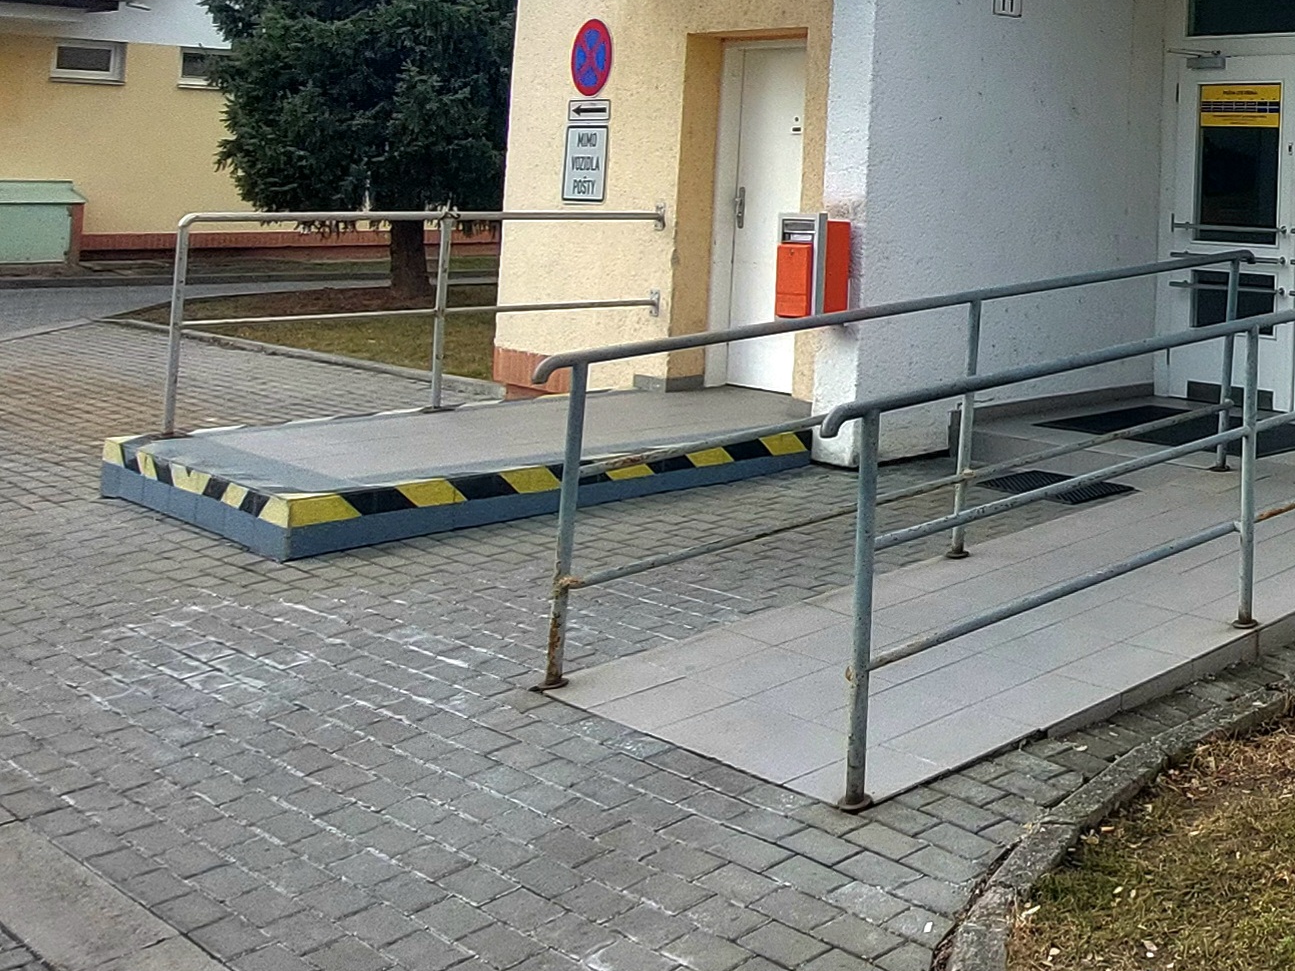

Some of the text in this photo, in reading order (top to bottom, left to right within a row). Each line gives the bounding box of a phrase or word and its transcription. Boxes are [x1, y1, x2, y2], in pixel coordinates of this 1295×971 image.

[577, 132, 598, 148] MIMO
[571, 156, 600, 171] VOZIDLA
[572, 175, 597, 196] POŠTY
